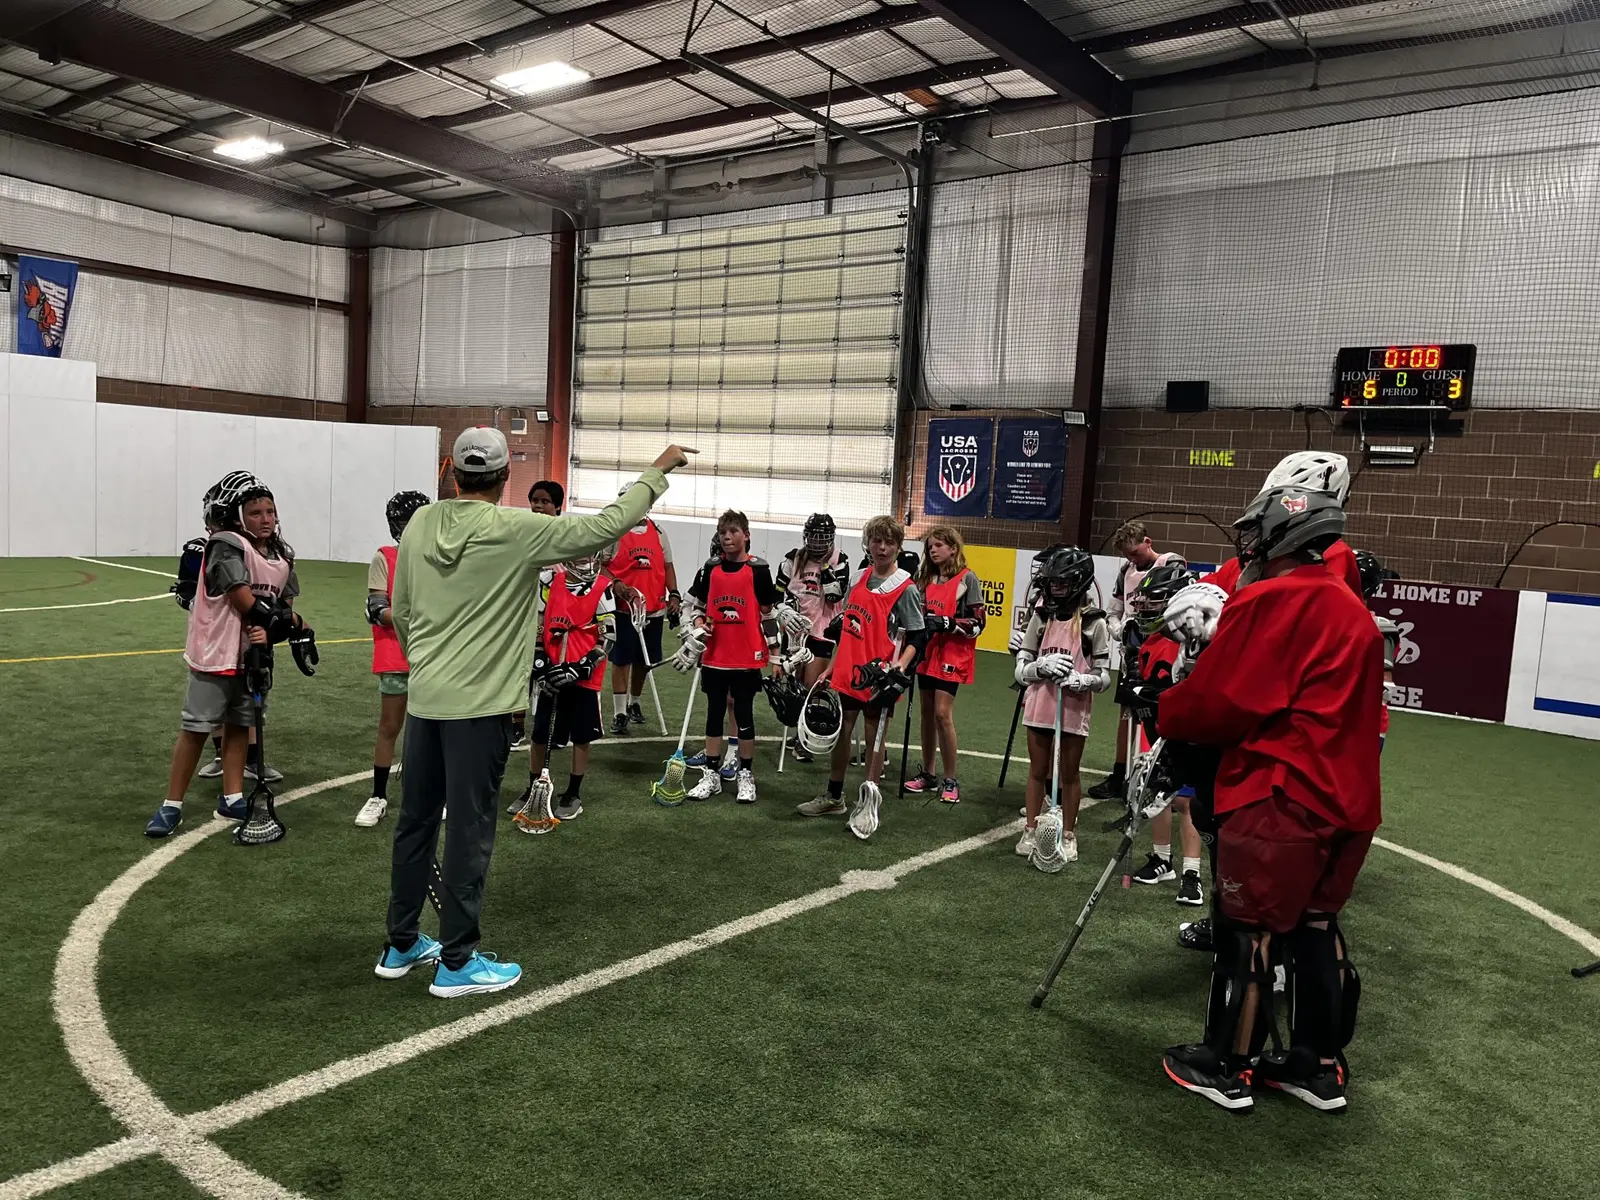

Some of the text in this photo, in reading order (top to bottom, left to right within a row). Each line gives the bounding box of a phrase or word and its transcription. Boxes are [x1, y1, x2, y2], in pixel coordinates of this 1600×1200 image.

[1384, 349, 1440, 368] 0:00
[1341, 369, 1466, 381] HOME GUEST
[1396, 372, 1407, 387] 0
[1363, 379, 1462, 399] 6 3
[1382, 388, 1418, 396] PERIOD
[941, 436, 978, 448] USA
[1189, 449, 1236, 467] HOME
[1392, 584, 1450, 604] HOME
[1456, 590, 1483, 607] OF
